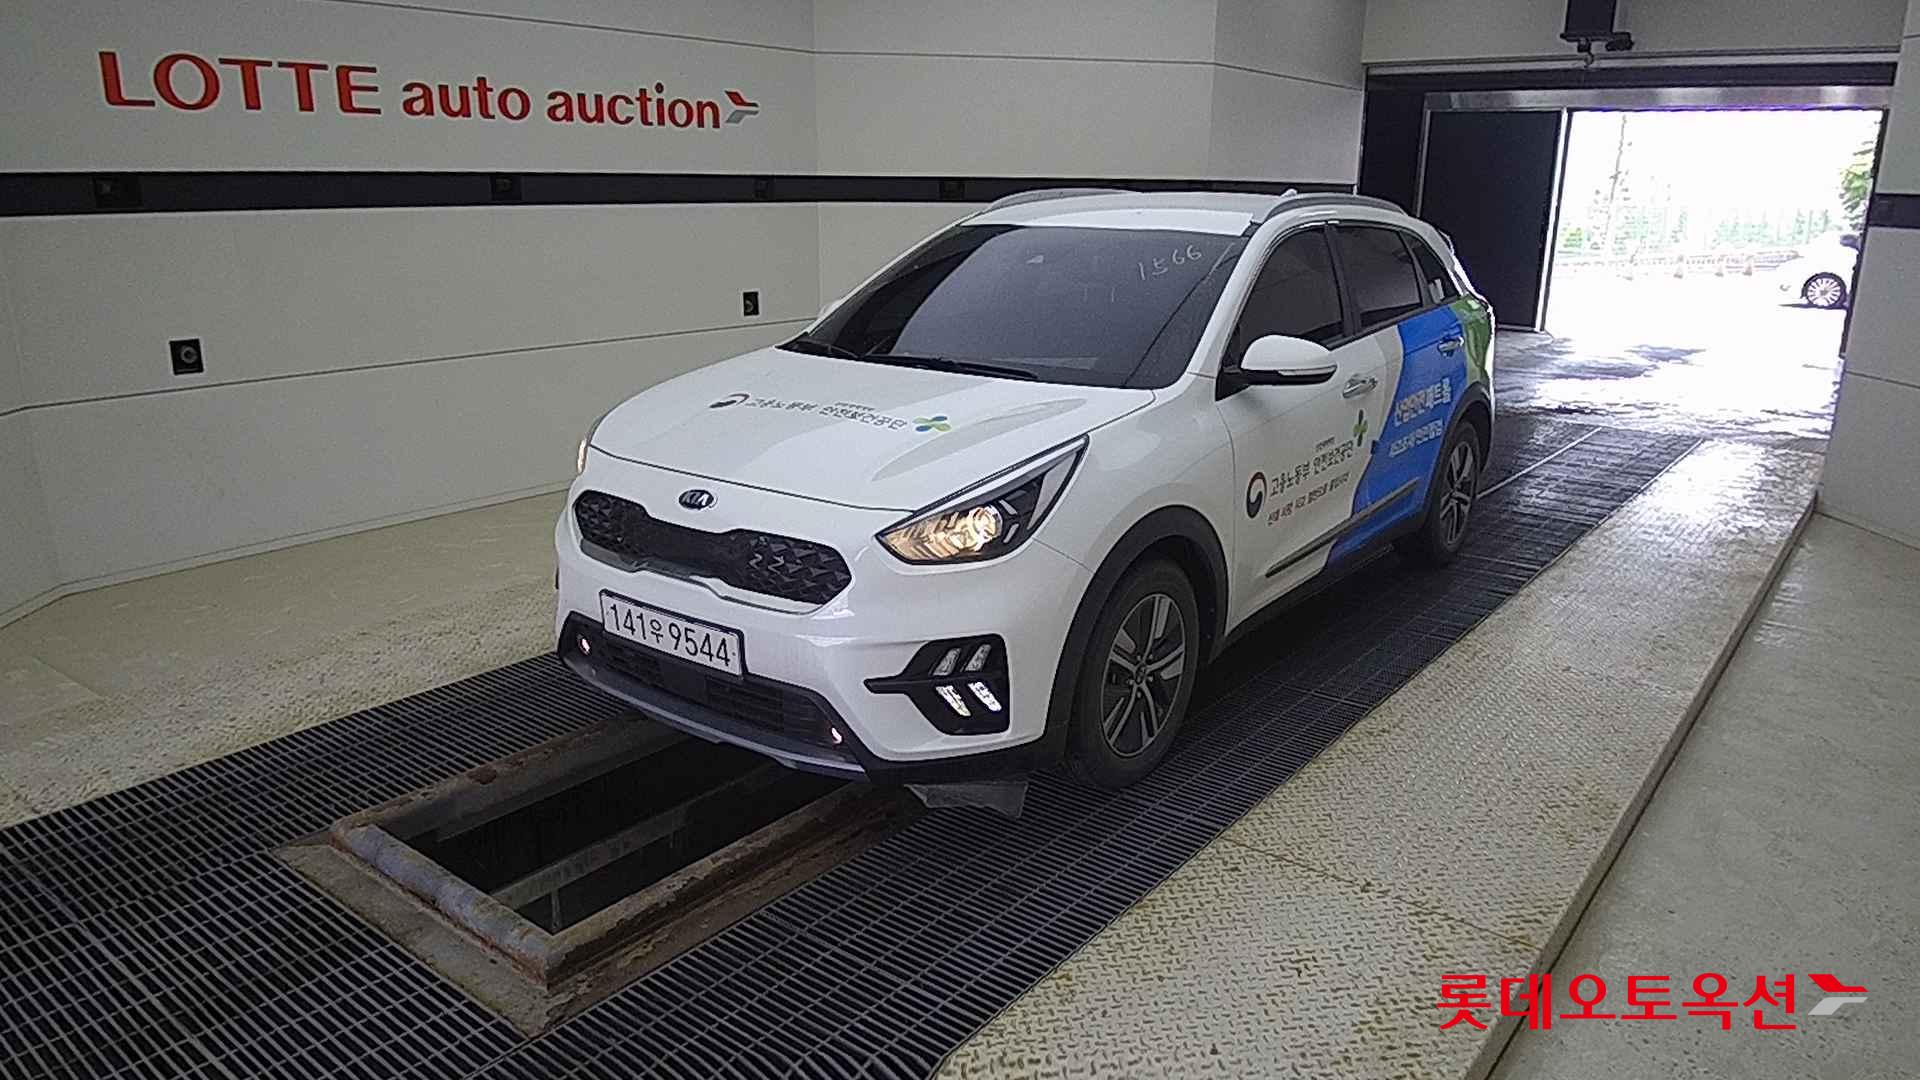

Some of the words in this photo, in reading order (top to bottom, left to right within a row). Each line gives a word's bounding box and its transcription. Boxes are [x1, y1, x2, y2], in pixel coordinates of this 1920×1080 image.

[99, 51, 381, 115] LOTTE
[402, 76, 531, 121] auto
[546, 83, 721, 129] auction
[1137, 244, 1202, 281] 1566
[1270, 460, 1311, 498] 고용노동부
[680, 491, 711, 507] KIA
